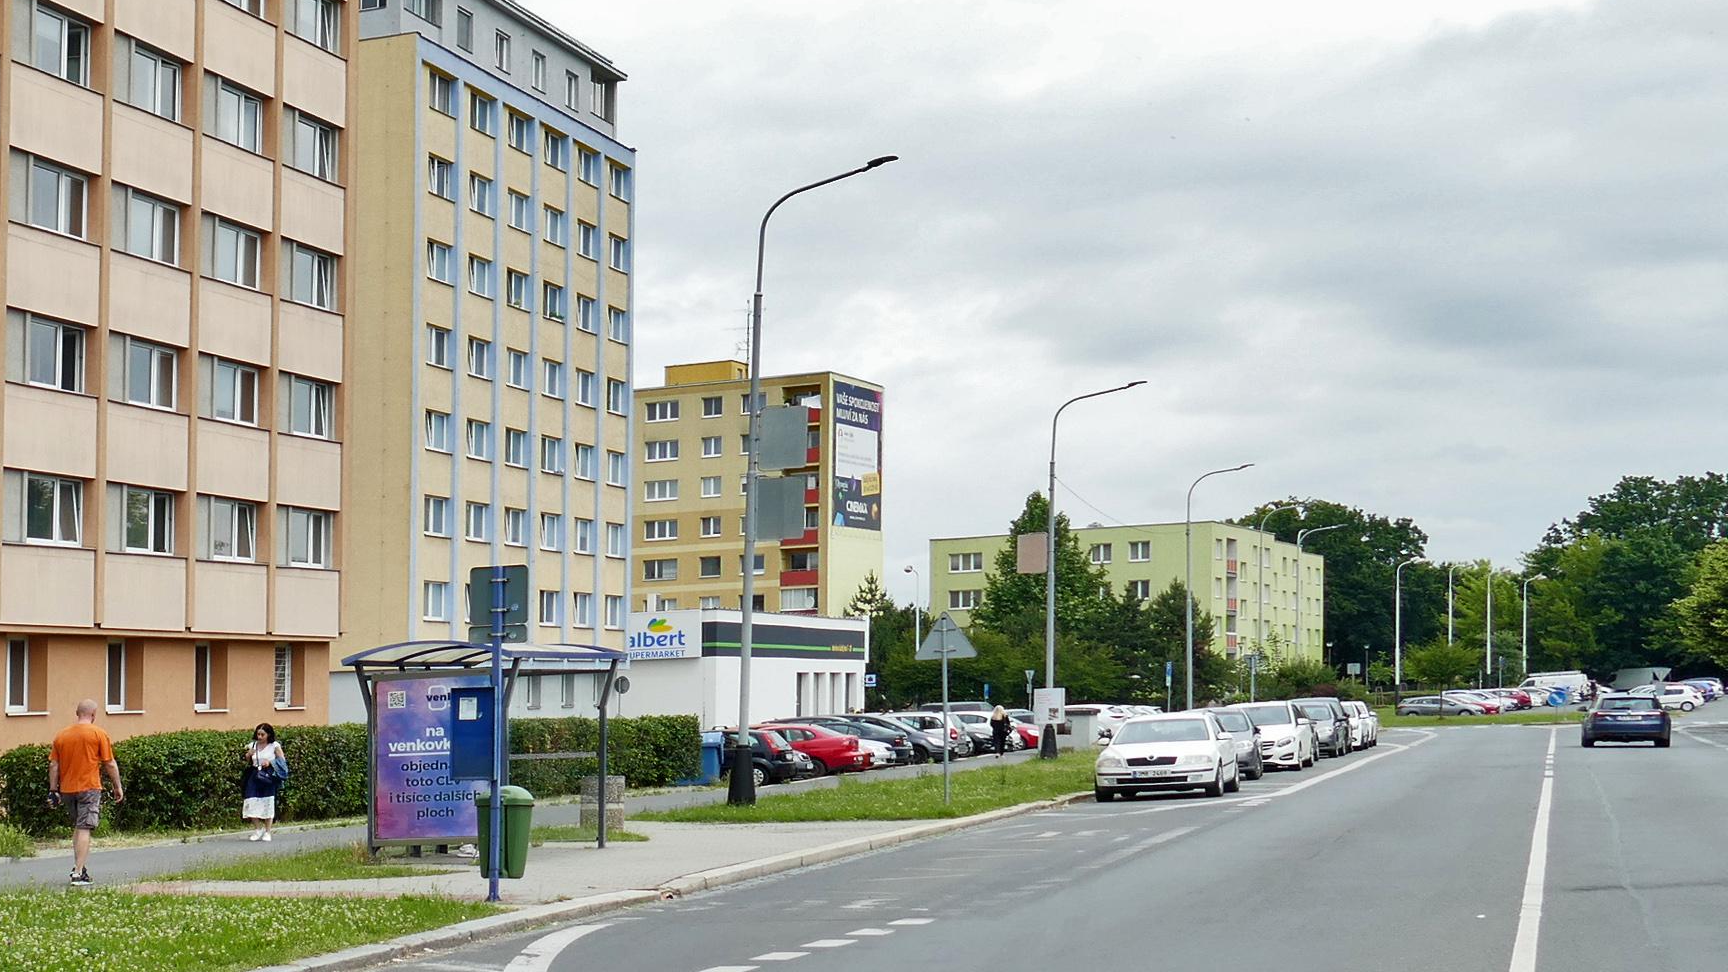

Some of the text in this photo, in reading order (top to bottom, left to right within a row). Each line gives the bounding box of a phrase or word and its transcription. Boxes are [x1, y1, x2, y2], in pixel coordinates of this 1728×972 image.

[629, 629, 686, 648] albert
[629, 649, 686, 659] UPERMARKET
[425, 726, 445, 737] na
[388, 737, 451, 752] venkovk
[401, 760, 450, 774] objedn
[405, 777, 433, 788] toto
[389, 790, 482, 804] i tisíce dalších
[417, 806, 455, 821] ploch
